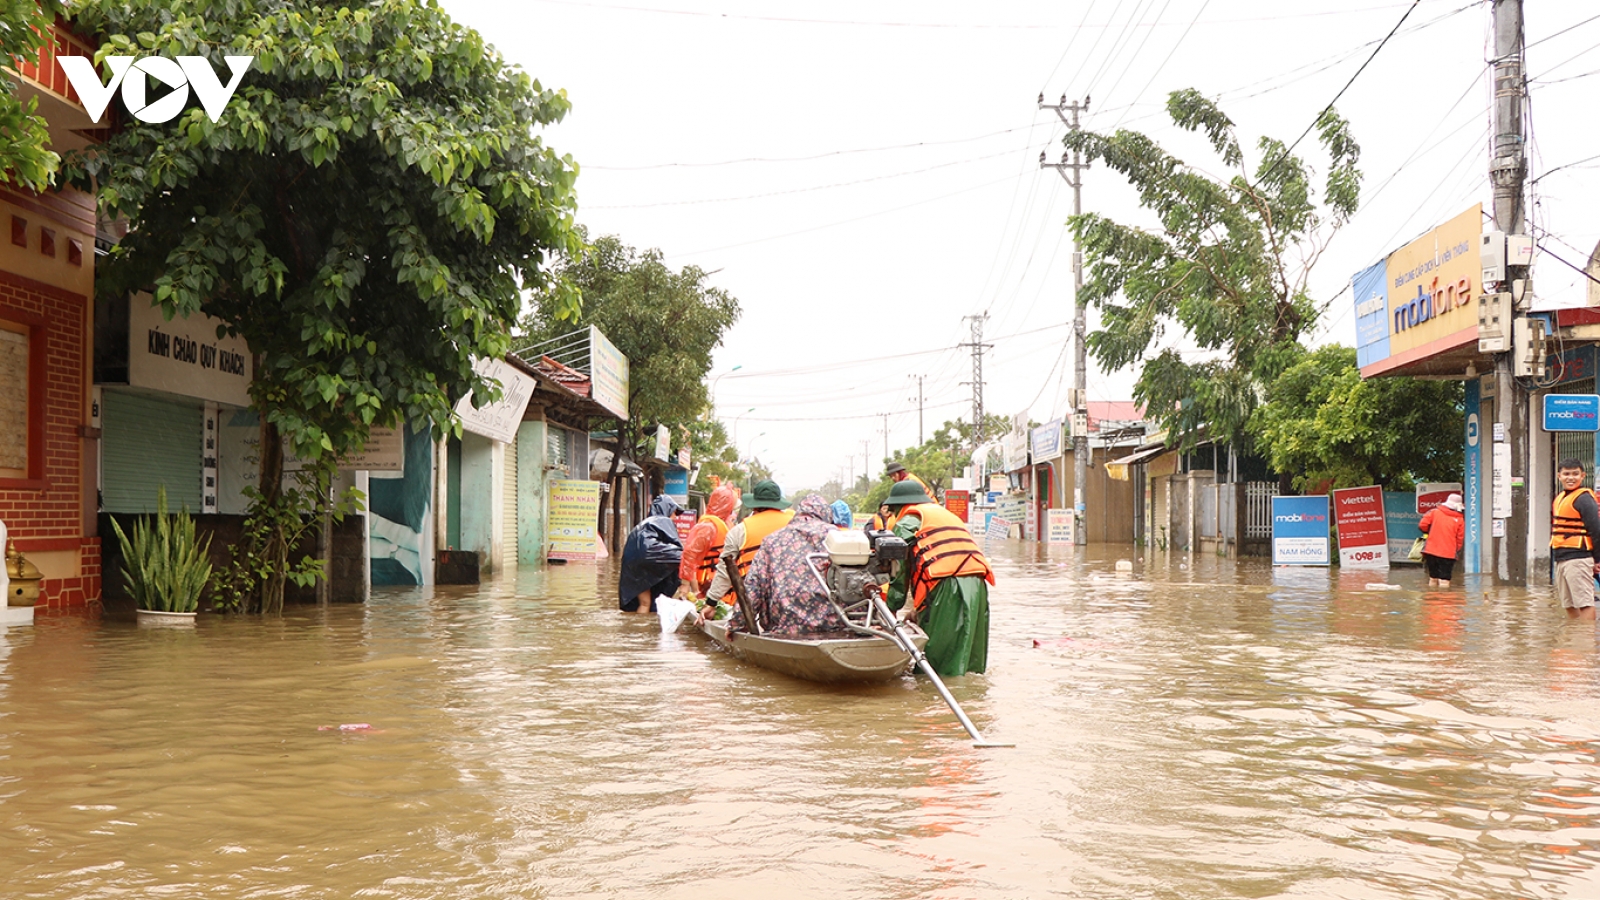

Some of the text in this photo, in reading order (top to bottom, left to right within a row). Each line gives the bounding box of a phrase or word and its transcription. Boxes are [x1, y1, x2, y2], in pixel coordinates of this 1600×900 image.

[1394, 275, 1471, 334] mobifone
[148, 326, 245, 376] KÍNH CHÀO QUÝ KHÁCH
[1548, 410, 1595, 419] mobifone
[1341, 495, 1375, 505] viettel
[1469, 476, 1477, 517] BÔNG
[1275, 513, 1326, 523] mobifone
[1355, 551, 1374, 561] 098
